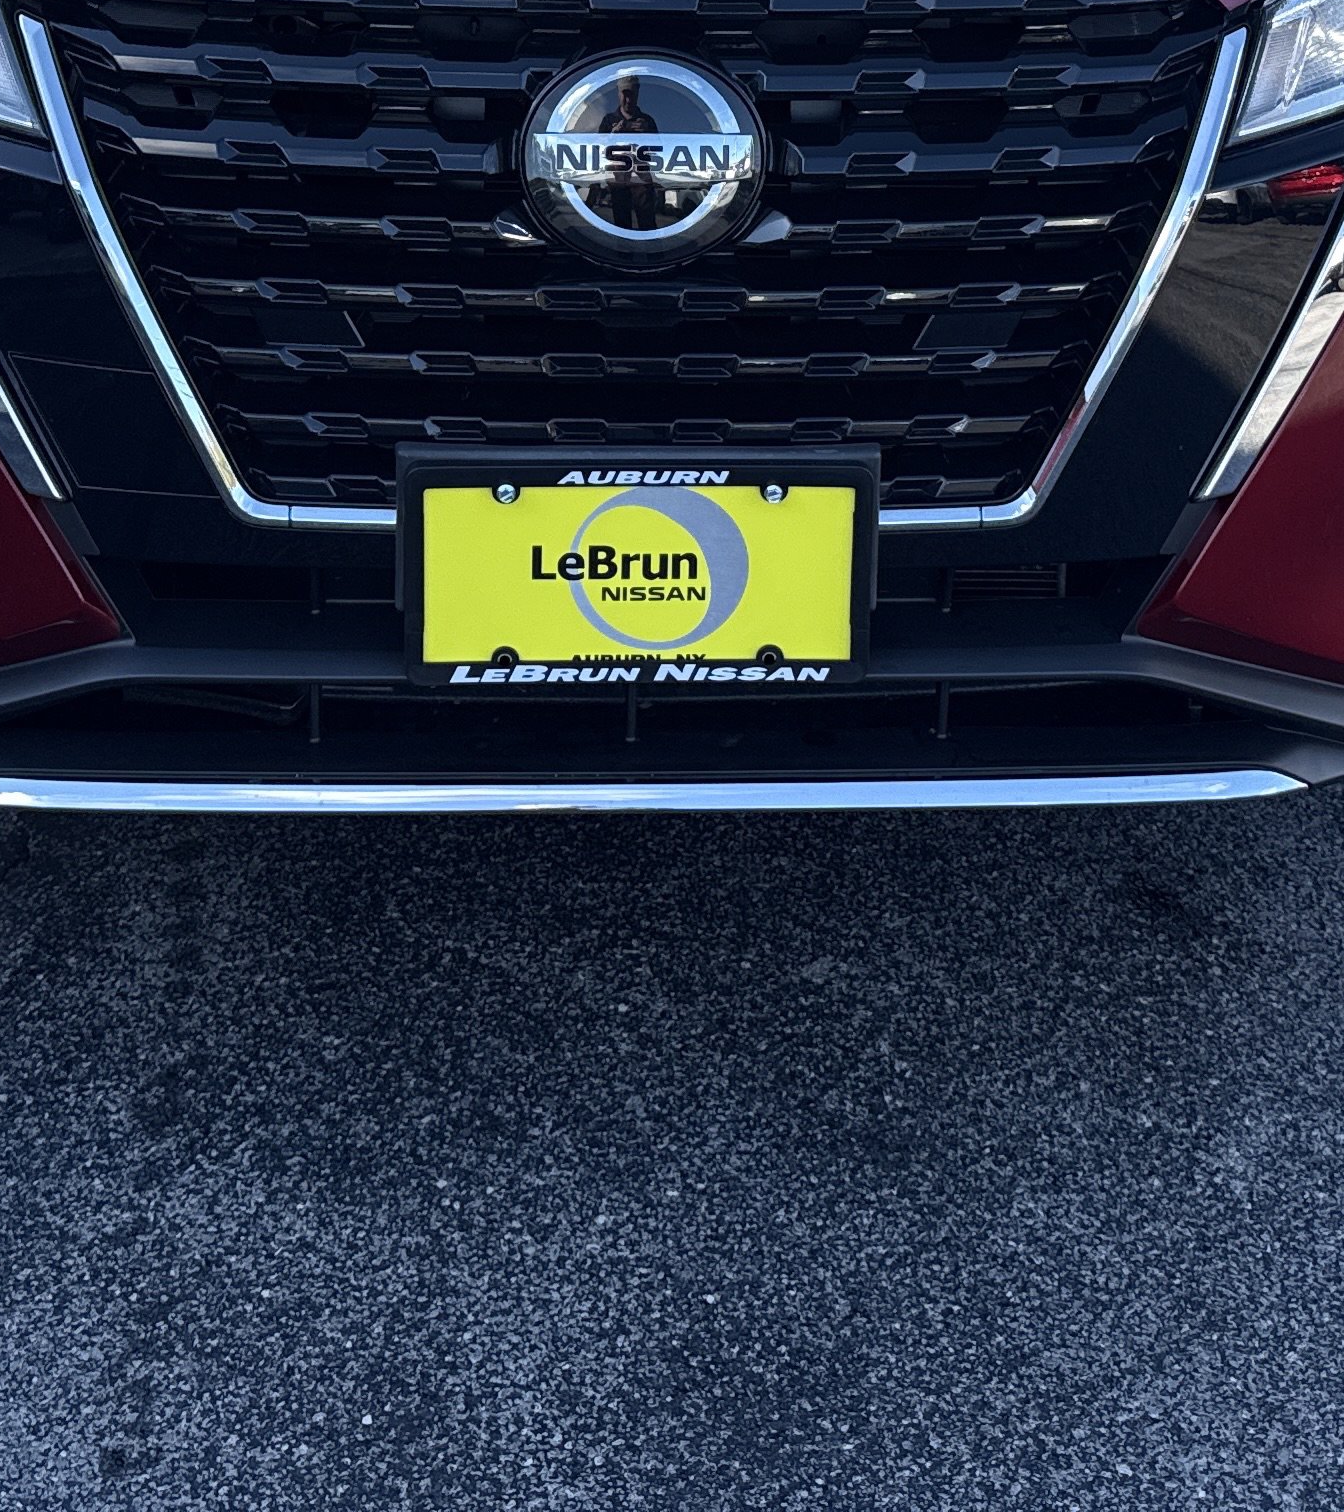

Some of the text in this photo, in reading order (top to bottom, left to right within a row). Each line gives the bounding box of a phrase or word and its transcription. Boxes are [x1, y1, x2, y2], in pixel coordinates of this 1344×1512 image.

[556, 144, 730, 172] NISSAN
[557, 470, 730, 485] AUBURN
[531, 545, 697, 580] LeBrun
[601, 586, 706, 601] NISSAN
